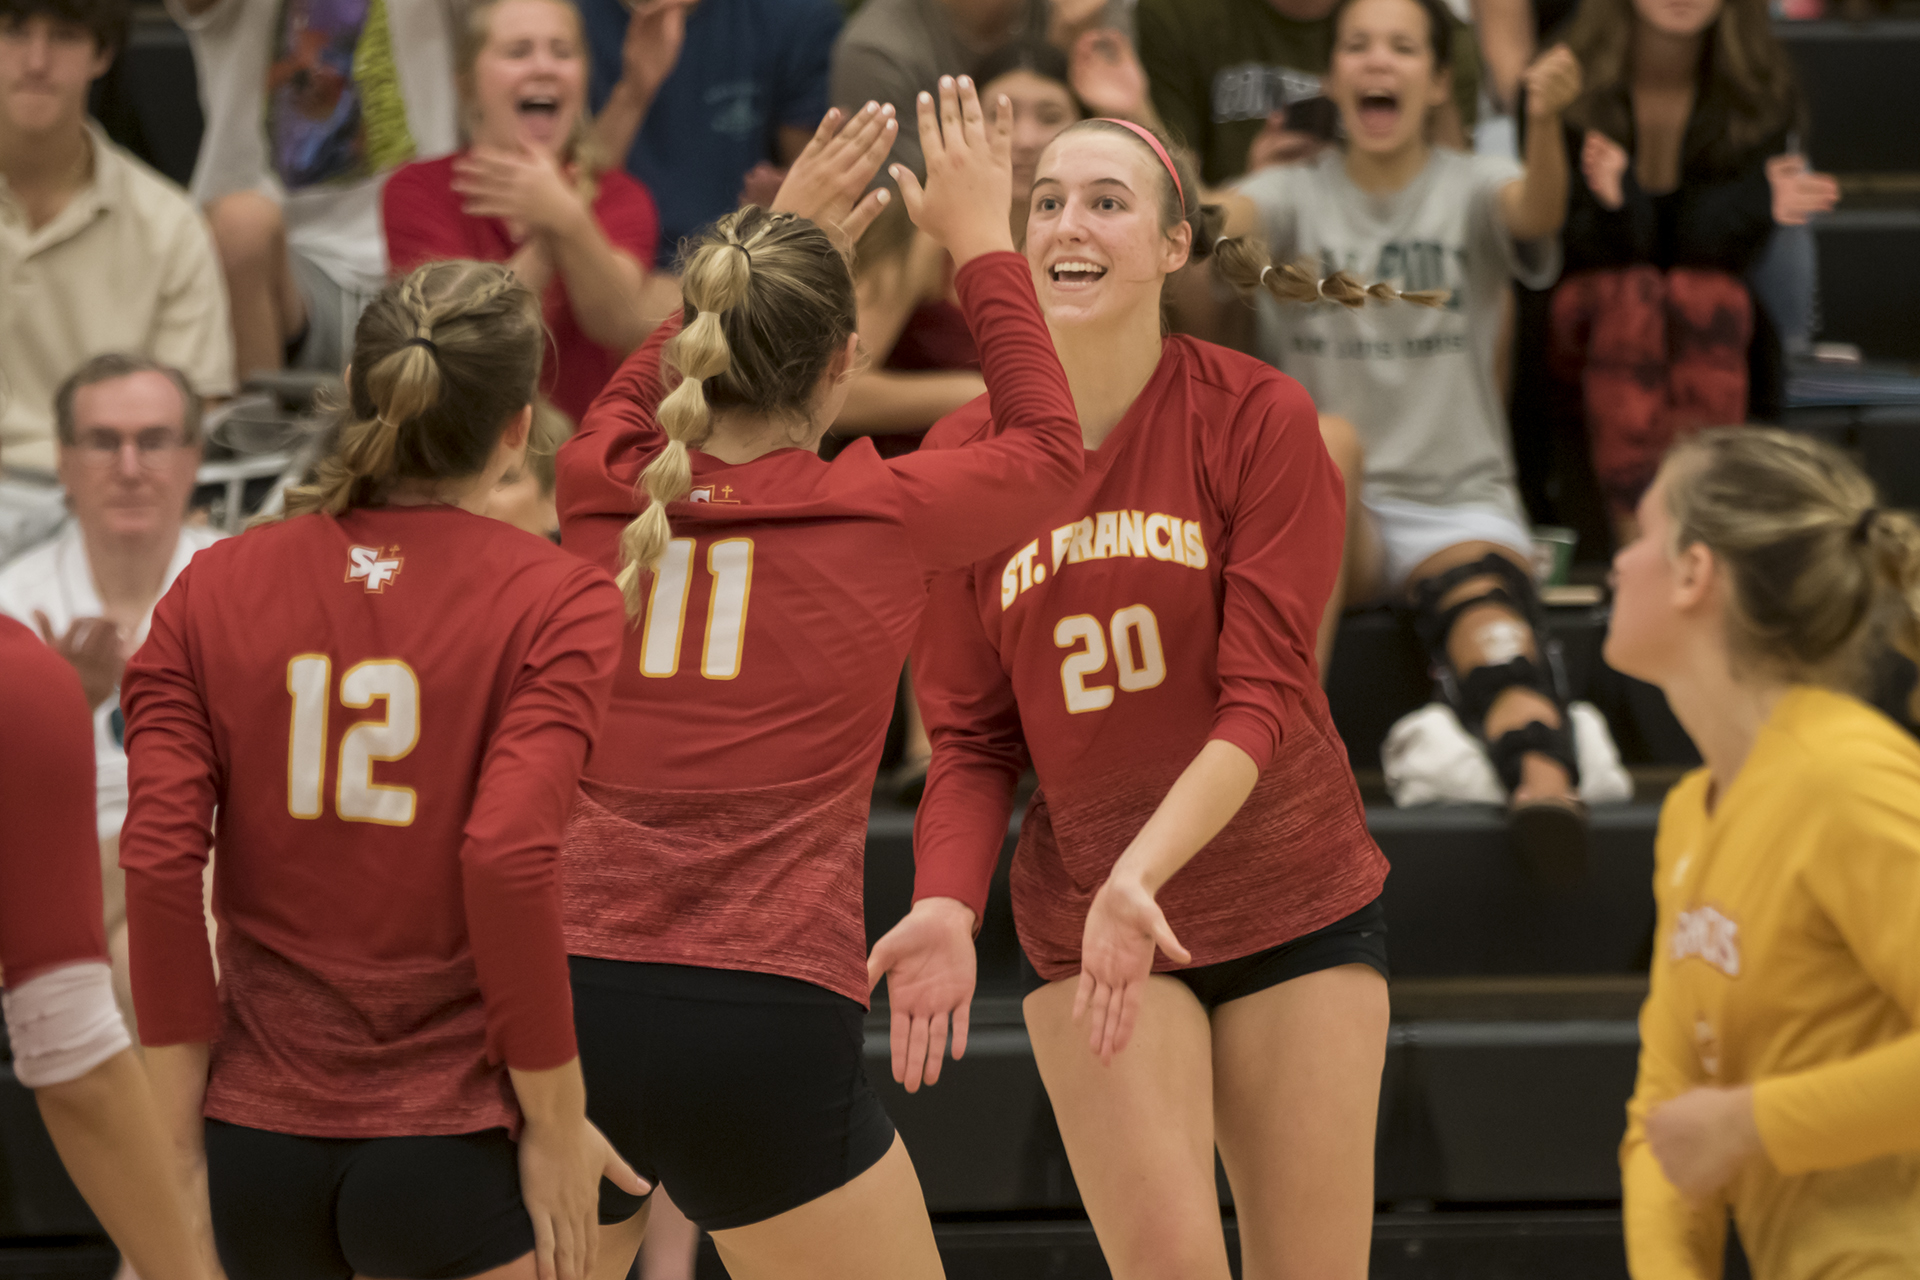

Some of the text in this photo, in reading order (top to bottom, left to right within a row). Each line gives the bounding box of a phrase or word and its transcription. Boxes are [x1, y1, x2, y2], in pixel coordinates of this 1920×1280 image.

[344, 545, 404, 594] SF
[639, 537, 755, 681] 11
[1001, 509, 1208, 612] ST. FRANCIS
[1053, 603, 1167, 715] 20
[286, 653, 420, 827] 12
